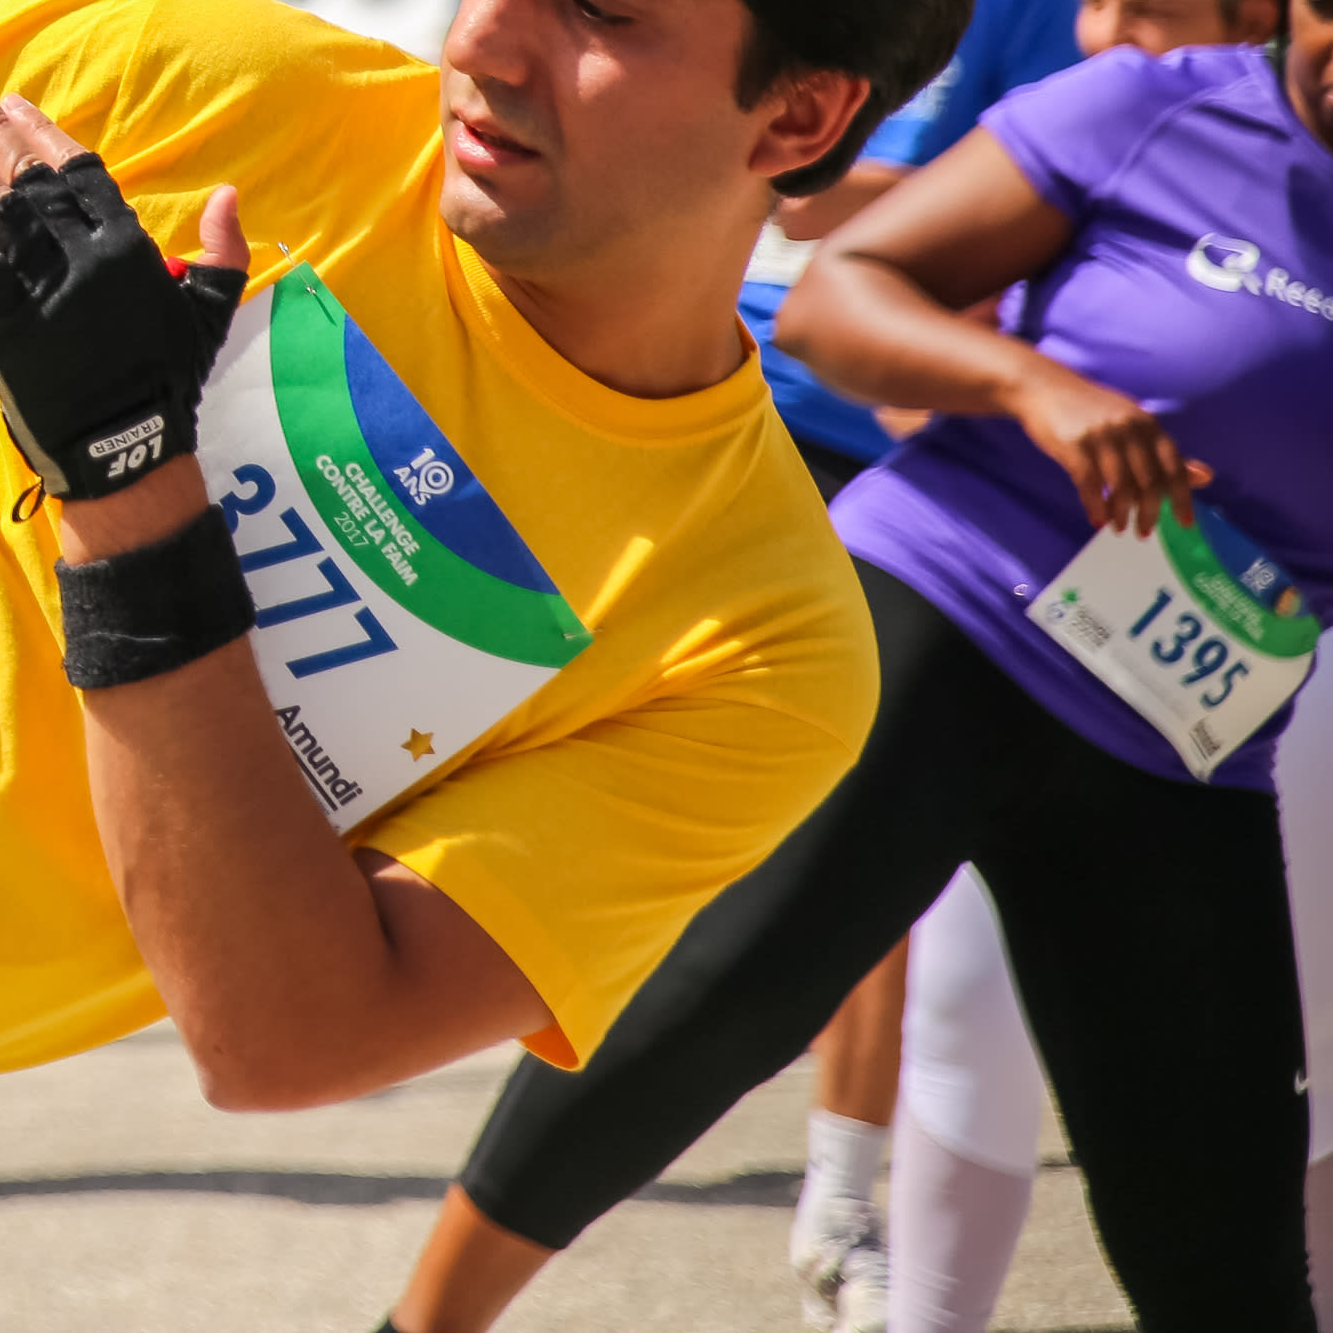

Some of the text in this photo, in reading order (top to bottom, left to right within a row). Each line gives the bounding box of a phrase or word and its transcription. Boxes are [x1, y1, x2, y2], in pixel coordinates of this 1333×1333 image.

[92, 417, 161, 456] TRAINER
[107, 433, 163, 478] LOF
[410, 447, 454, 495] 10
[315, 454, 419, 587] CONTRE LA FAIM
[345, 462, 421, 557] CHALLENGE
[393, 466, 432, 506] ANS
[333, 511, 370, 547] 2017
[220, 463, 400, 680] 3777
[1129, 586, 1250, 710] 1395
[274, 704, 364, 806] Amundi
